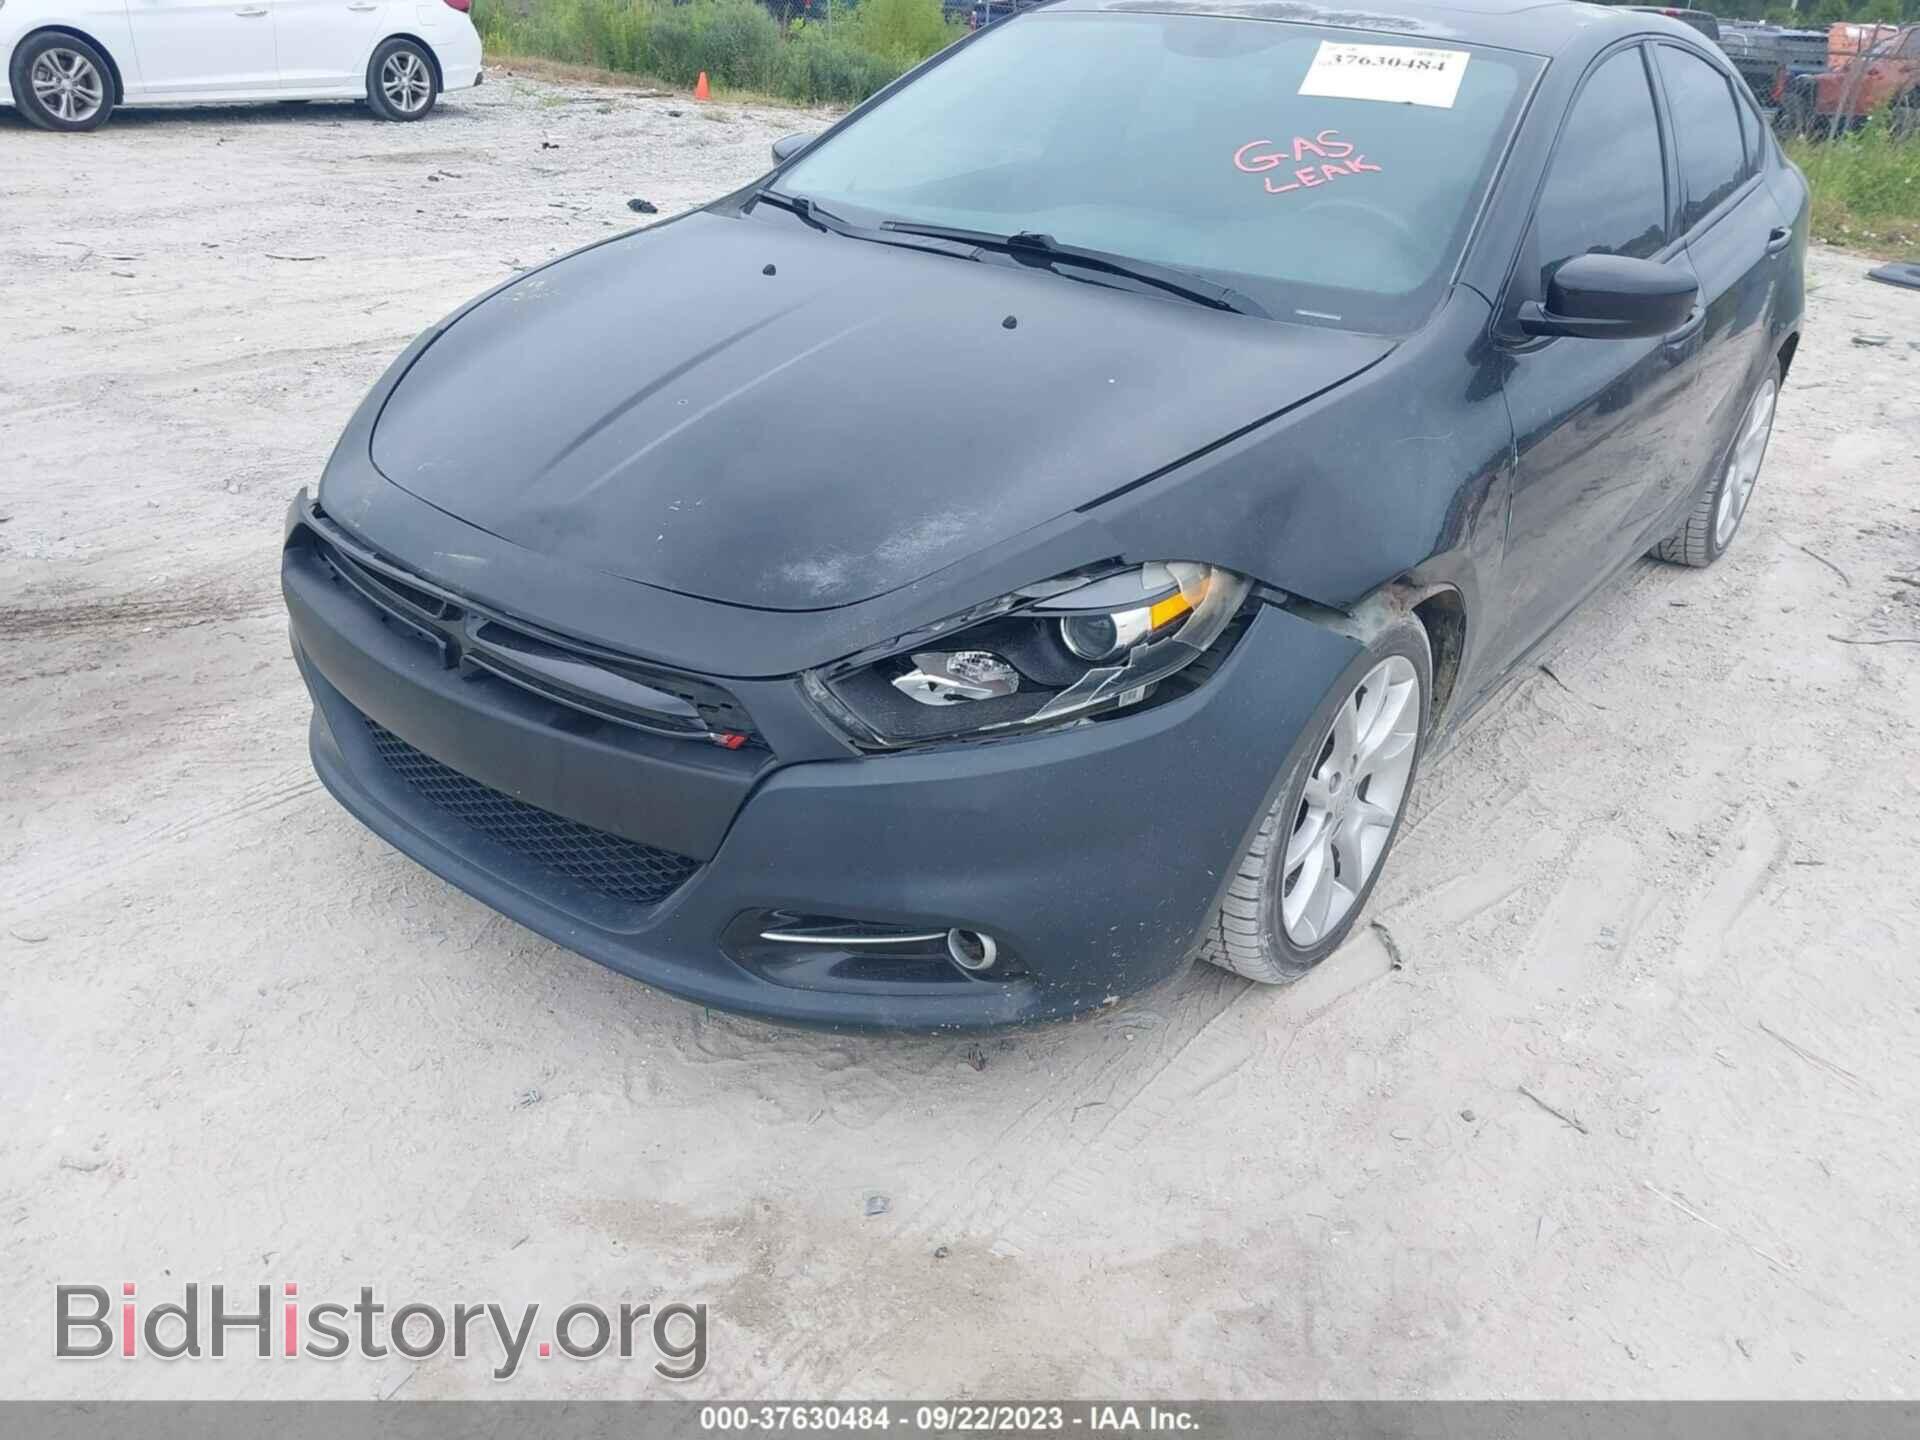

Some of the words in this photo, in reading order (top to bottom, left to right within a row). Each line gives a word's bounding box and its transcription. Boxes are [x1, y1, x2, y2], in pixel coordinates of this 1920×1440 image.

[1331, 54, 1446, 72] 37630484
[1233, 129, 1354, 173] GAS
[1264, 154, 1383, 194] LEAK
